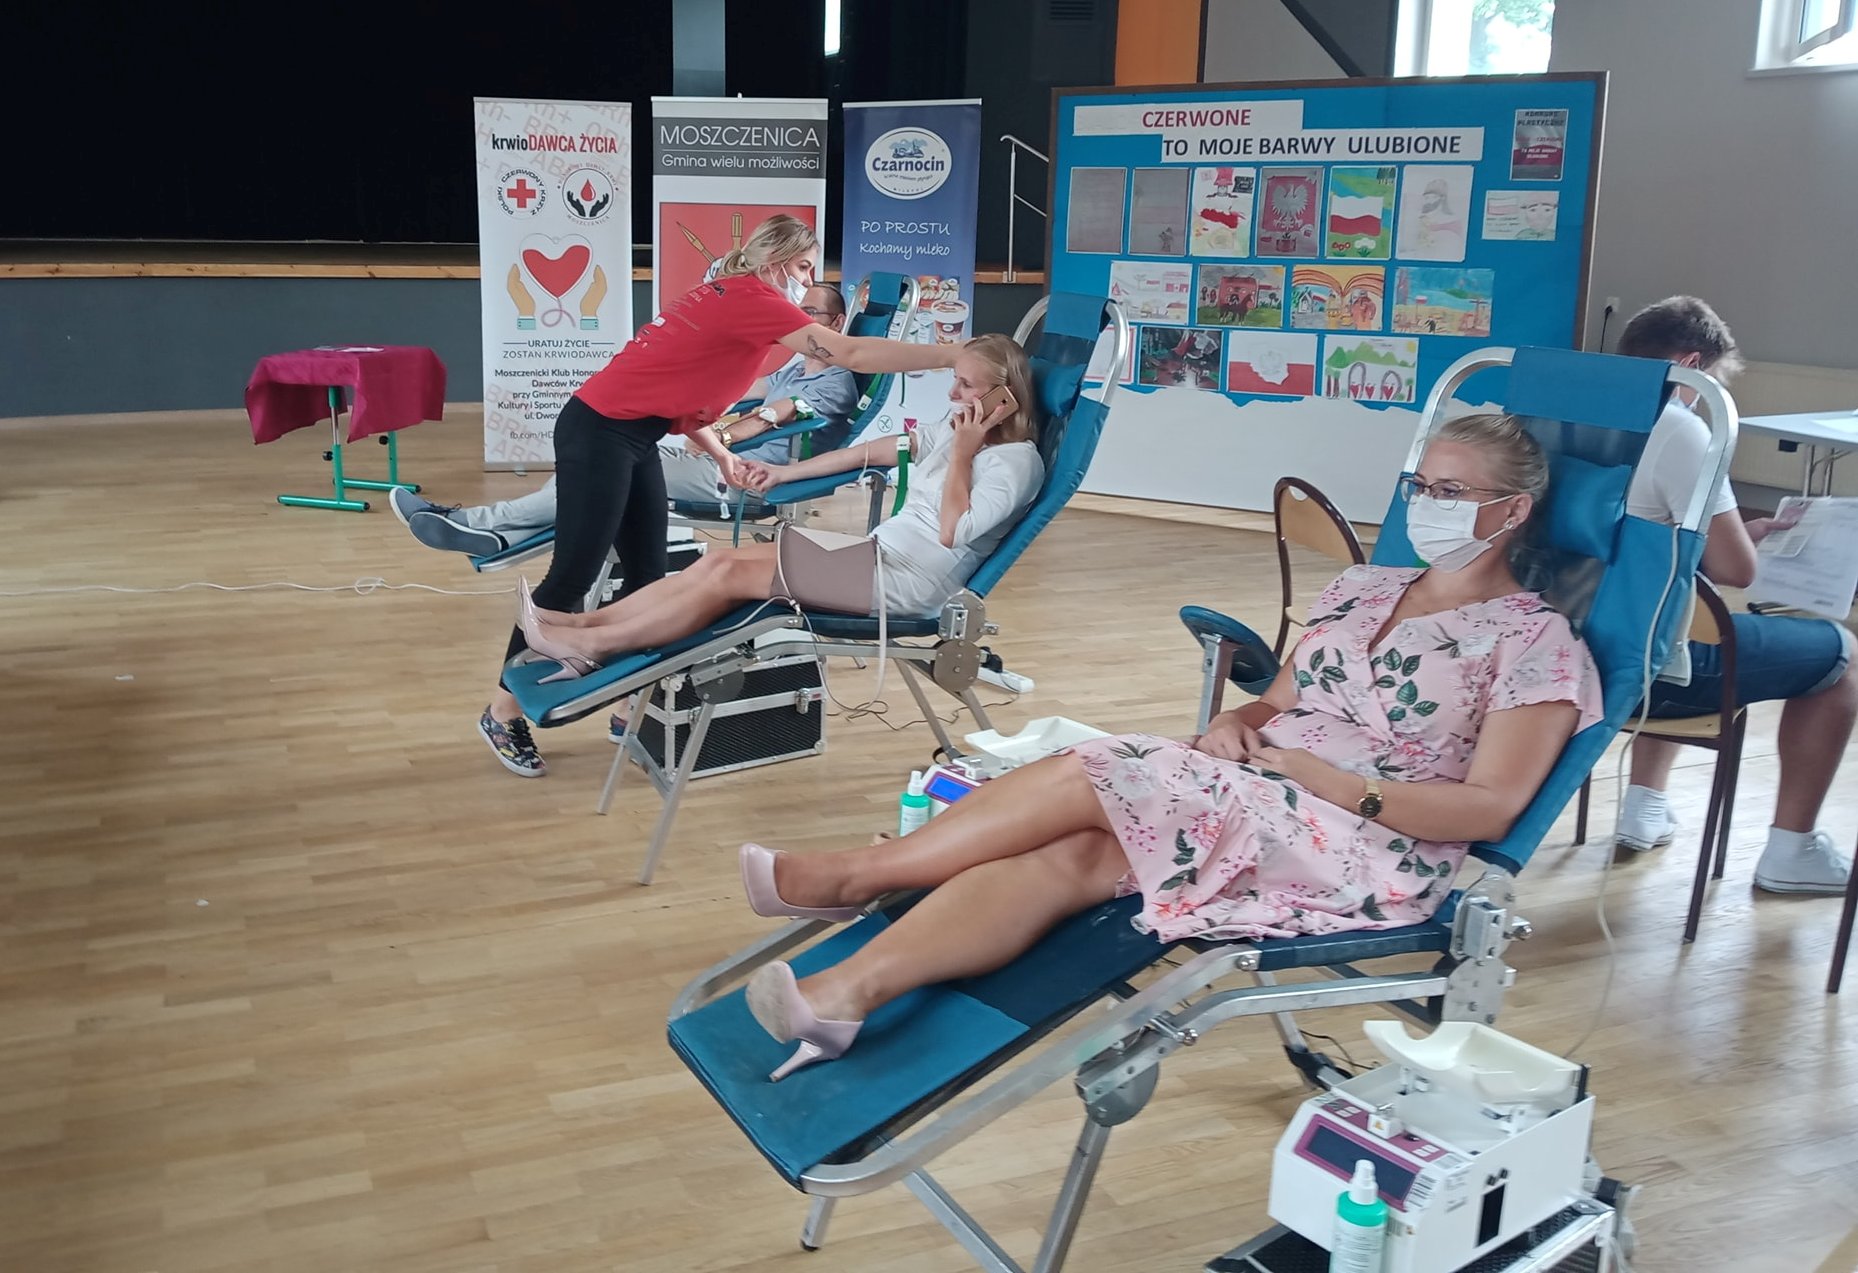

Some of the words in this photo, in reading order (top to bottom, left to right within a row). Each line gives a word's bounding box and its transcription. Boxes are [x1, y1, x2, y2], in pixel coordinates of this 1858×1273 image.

[1142, 108, 1252, 128] CZERWONE
[491, 133, 576, 153] krwioDAWCA
[579, 133, 618, 154] ŻYCIA
[660, 125, 821, 148] MOSZCZENICA
[1163, 138, 1189, 156] TO
[1199, 137, 1253, 156] MOJE
[1258, 136, 1337, 155] BARWY
[1347, 135, 1462, 155] ULUBIONE
[662, 154, 707, 168] Gmina
[711, 155, 745, 169] wielu
[748, 156, 820, 170] możliwości
[872, 156, 945, 172] Czarnocin
[501, 169, 545, 187] CZERWONY
[861, 221, 881, 233] PO
[885, 221, 951, 235] PROSTU
[859, 242, 913, 261] Kochamy
[916, 242, 951, 256] mleko
[528, 340, 563, 348] URATUJ
[494, 369, 549, 377] Moszczenicki
[551, 369, 571, 377] Klub
[532, 379, 567, 388] Dawców
[513, 391, 531, 400] przy
[532, 390, 572, 400] Gminnym
[498, 401, 529, 411] Kultury
[534, 401, 562, 410] Sportu
